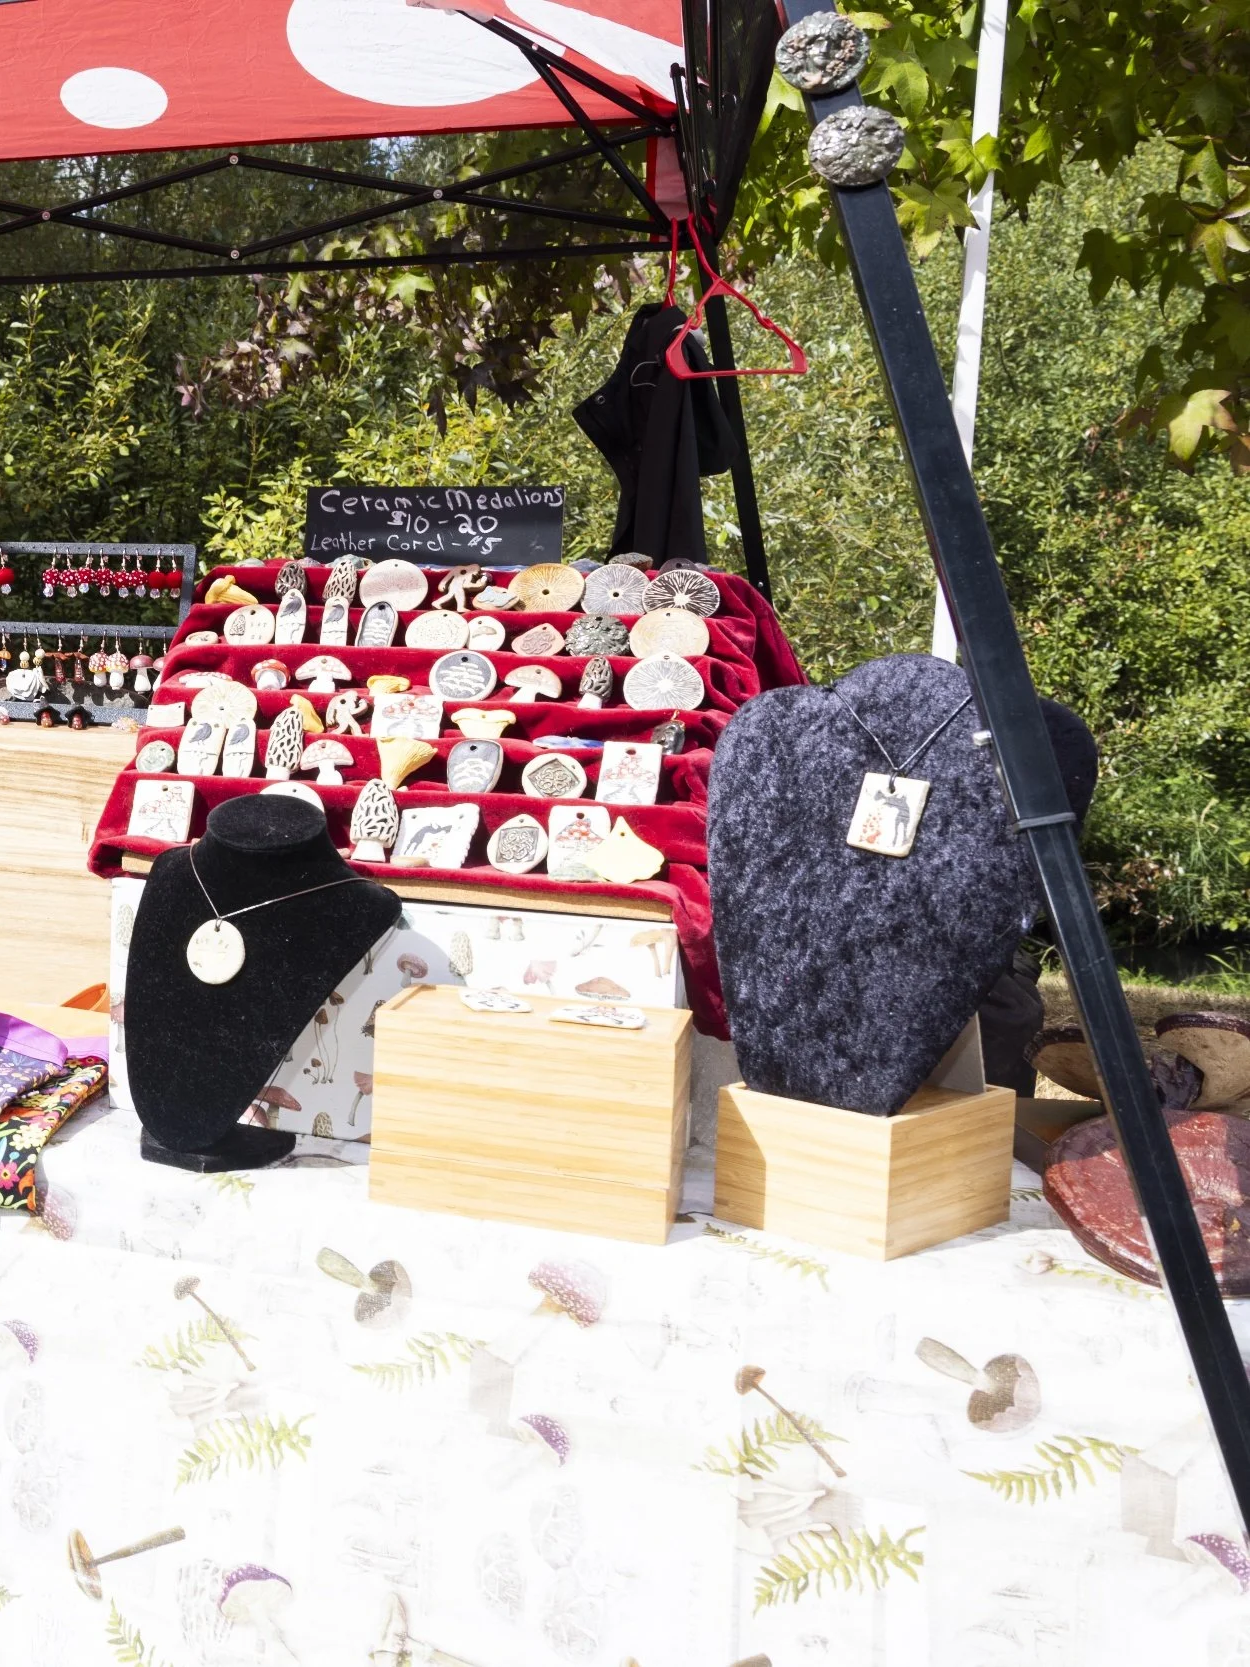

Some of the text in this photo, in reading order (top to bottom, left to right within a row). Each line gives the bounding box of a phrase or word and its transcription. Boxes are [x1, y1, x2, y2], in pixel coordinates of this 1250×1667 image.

[320, 486, 565, 515] Ceramic Medalions
[310, 531, 377, 552] Leather
[387, 533, 445, 552] Cord
